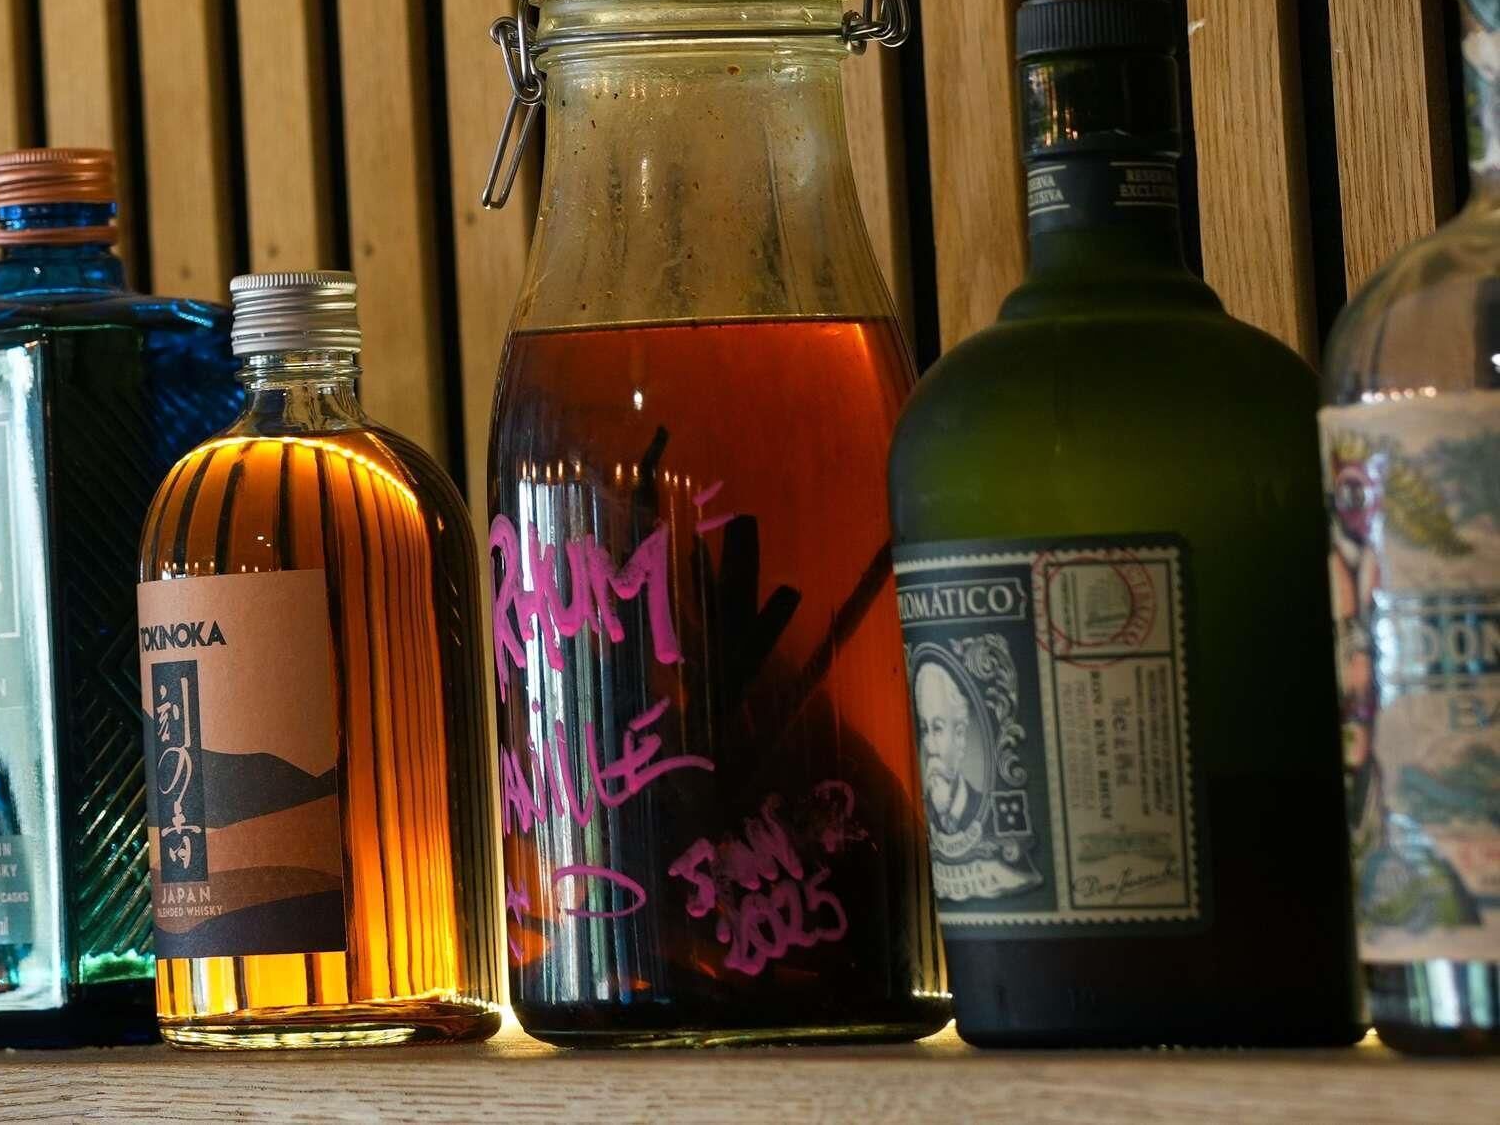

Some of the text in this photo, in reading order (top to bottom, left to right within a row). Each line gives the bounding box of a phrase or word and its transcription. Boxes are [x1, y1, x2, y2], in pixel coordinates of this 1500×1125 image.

[490, 513, 685, 685] RHUM
[897, 585, 1014, 620] OMÁTICO
[140, 621, 227, 652] TOKINOKA
[162, 886, 211, 905] JAPAN
[186, 905, 223, 916] WHISKY
